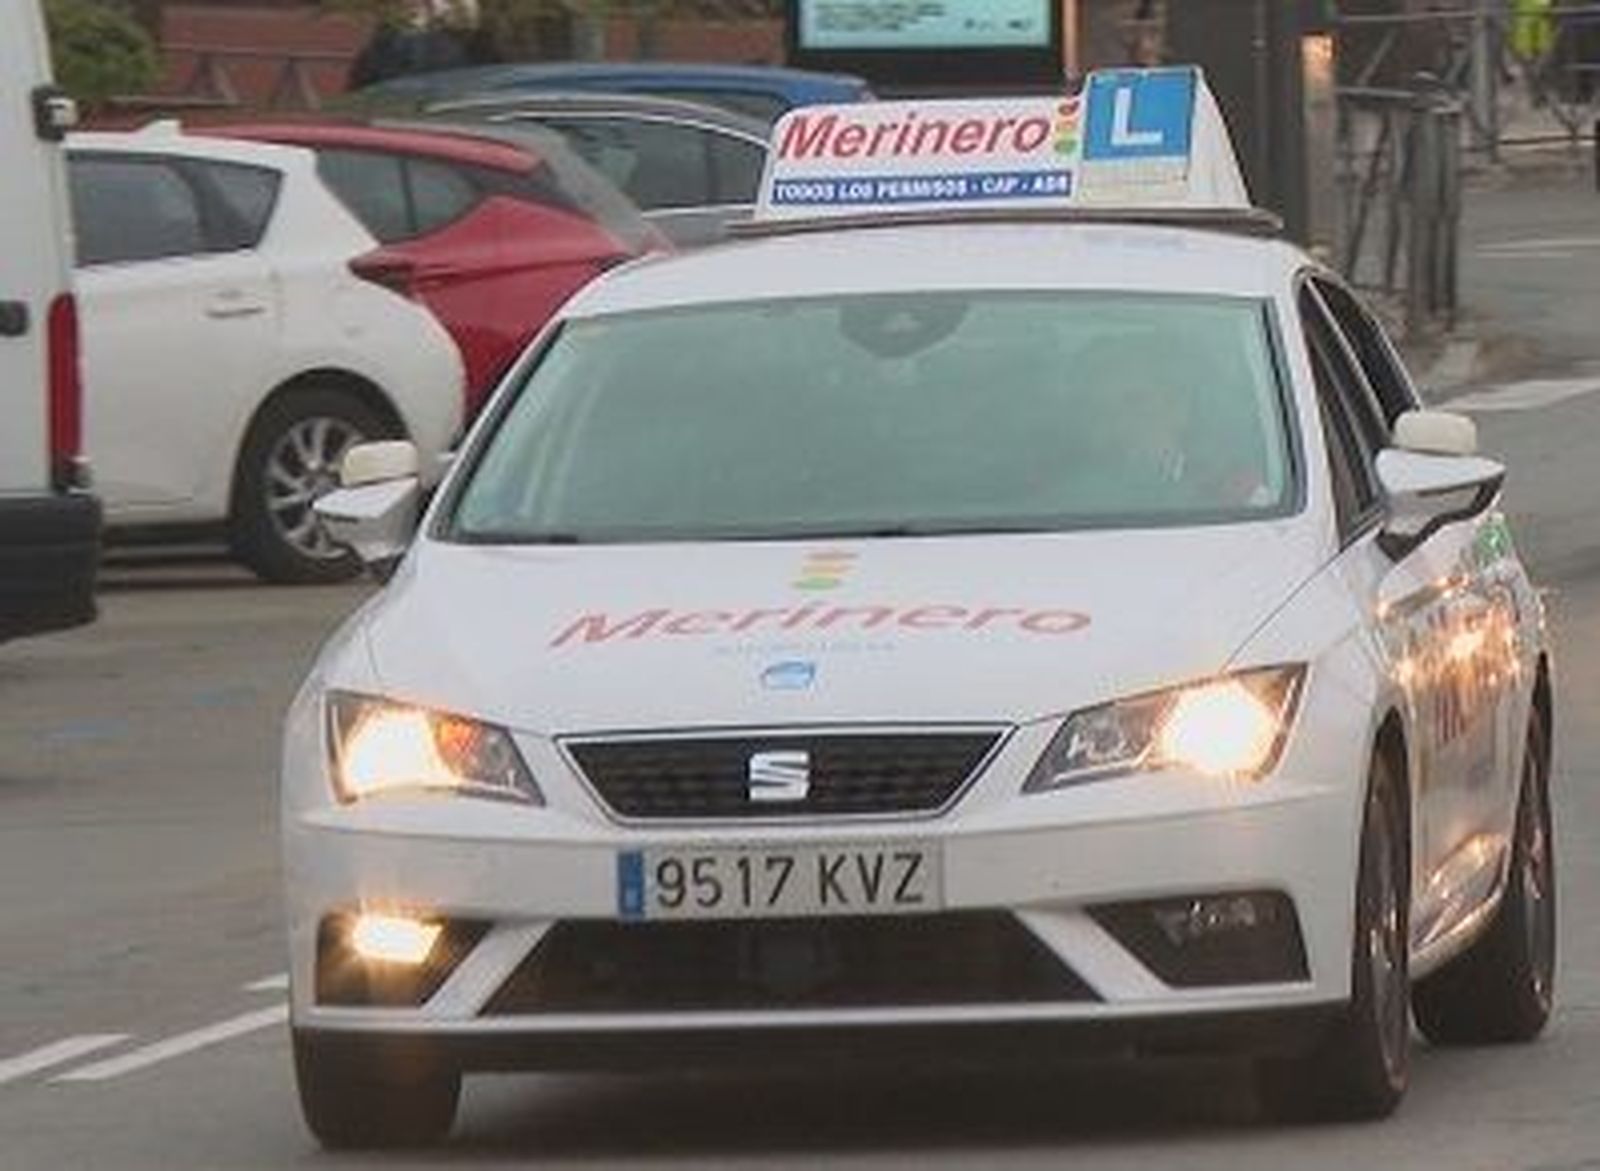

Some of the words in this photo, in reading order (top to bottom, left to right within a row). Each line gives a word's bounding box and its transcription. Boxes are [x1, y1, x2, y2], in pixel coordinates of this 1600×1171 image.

[776, 110, 1051, 160] Merinero
[1111, 87, 1164, 146] L
[775, 183, 835, 202] TODOS
[838, 182, 874, 200] LOS
[878, 178, 967, 200] PERMISOS
[981, 176, 1018, 194] CAP
[550, 601, 1092, 648] Merinero
[655, 856, 796, 909] 9517
[818, 851, 923, 904] KVZ
